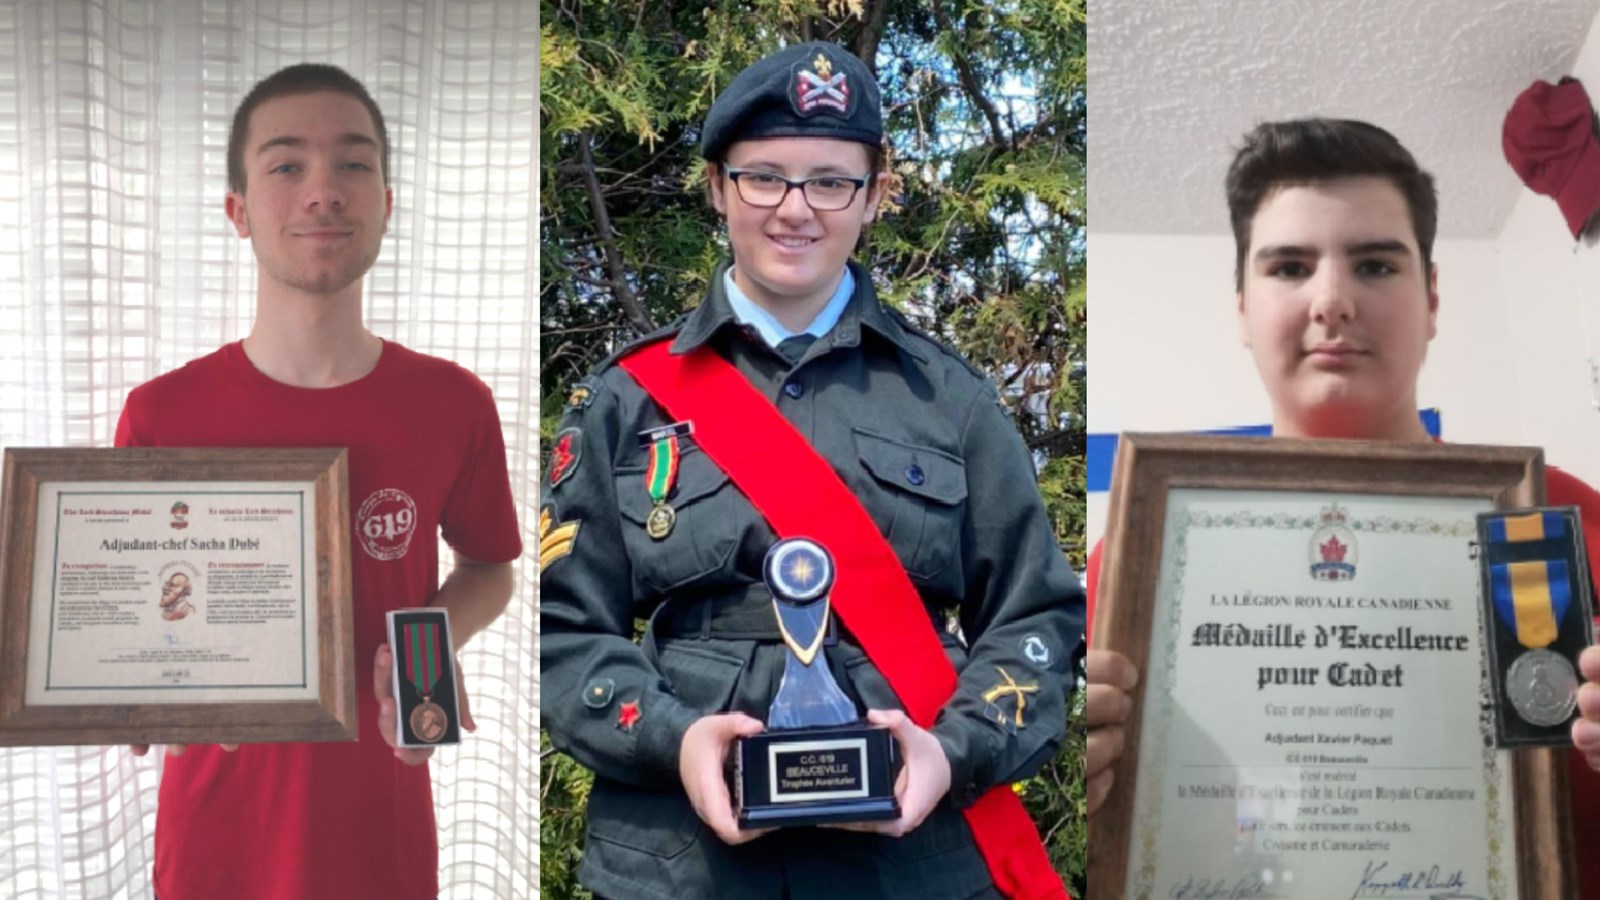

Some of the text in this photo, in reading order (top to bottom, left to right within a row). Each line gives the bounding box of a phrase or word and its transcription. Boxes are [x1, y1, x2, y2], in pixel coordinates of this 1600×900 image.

[363, 508, 413, 541] 619
[100, 537, 261, 553] Adjudant-chef Sacha Dubé
[1210, 588, 1453, 610] LA LÉGION ROYALE CANADIENNE
[1190, 623, 1470, 651] Médaille d'Excellence
[1257, 662, 1404, 690] pour Cadet
[1264, 703, 1288, 717] Ceci
[1264, 732, 1393, 746] Adjudant Xavier Paquet
[786, 764, 849, 777] BEAUCEVILLE
[1337, 786, 1373, 802] Légion
[1376, 786, 1412, 802] Royale
[1414, 786, 1475, 801] Canadienne
[1321, 803, 1359, 816] Cadets
